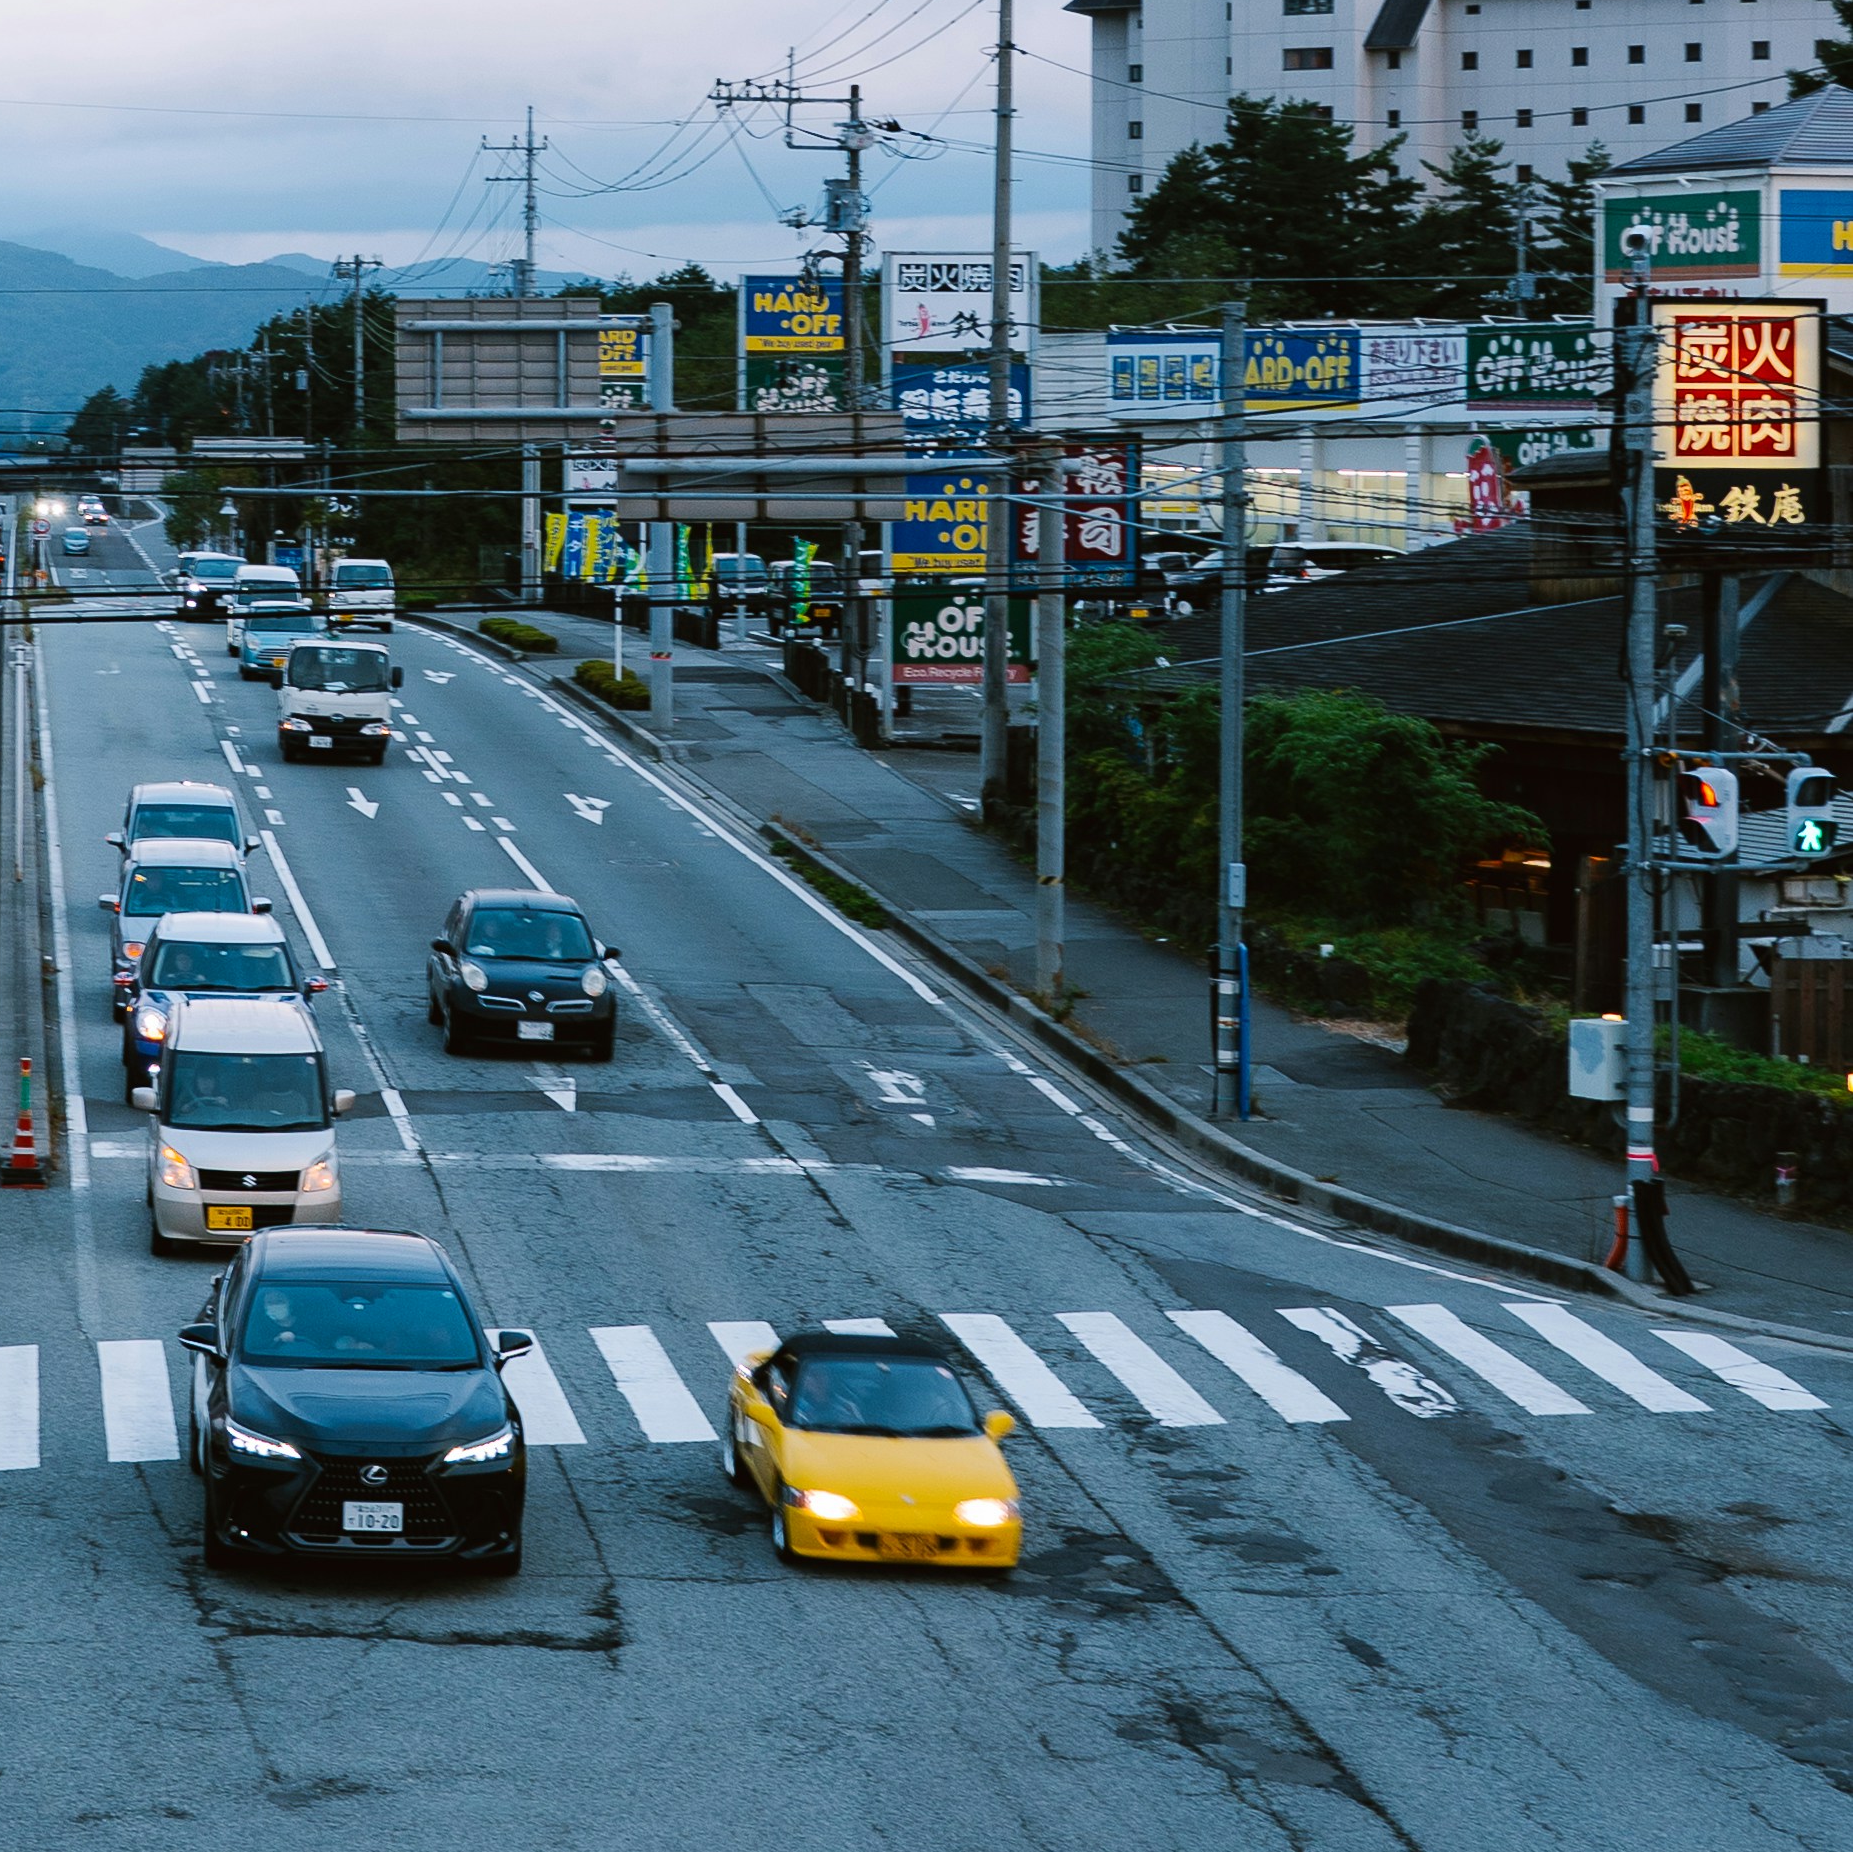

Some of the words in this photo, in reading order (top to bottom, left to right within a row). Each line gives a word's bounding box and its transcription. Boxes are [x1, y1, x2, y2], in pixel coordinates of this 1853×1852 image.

[1667, 213, 1740, 255] HOUSE
[1677, 321, 1793, 379] 炭火
[1678, 393, 1792, 451] 焼肉
[937, 606, 986, 634] OF
